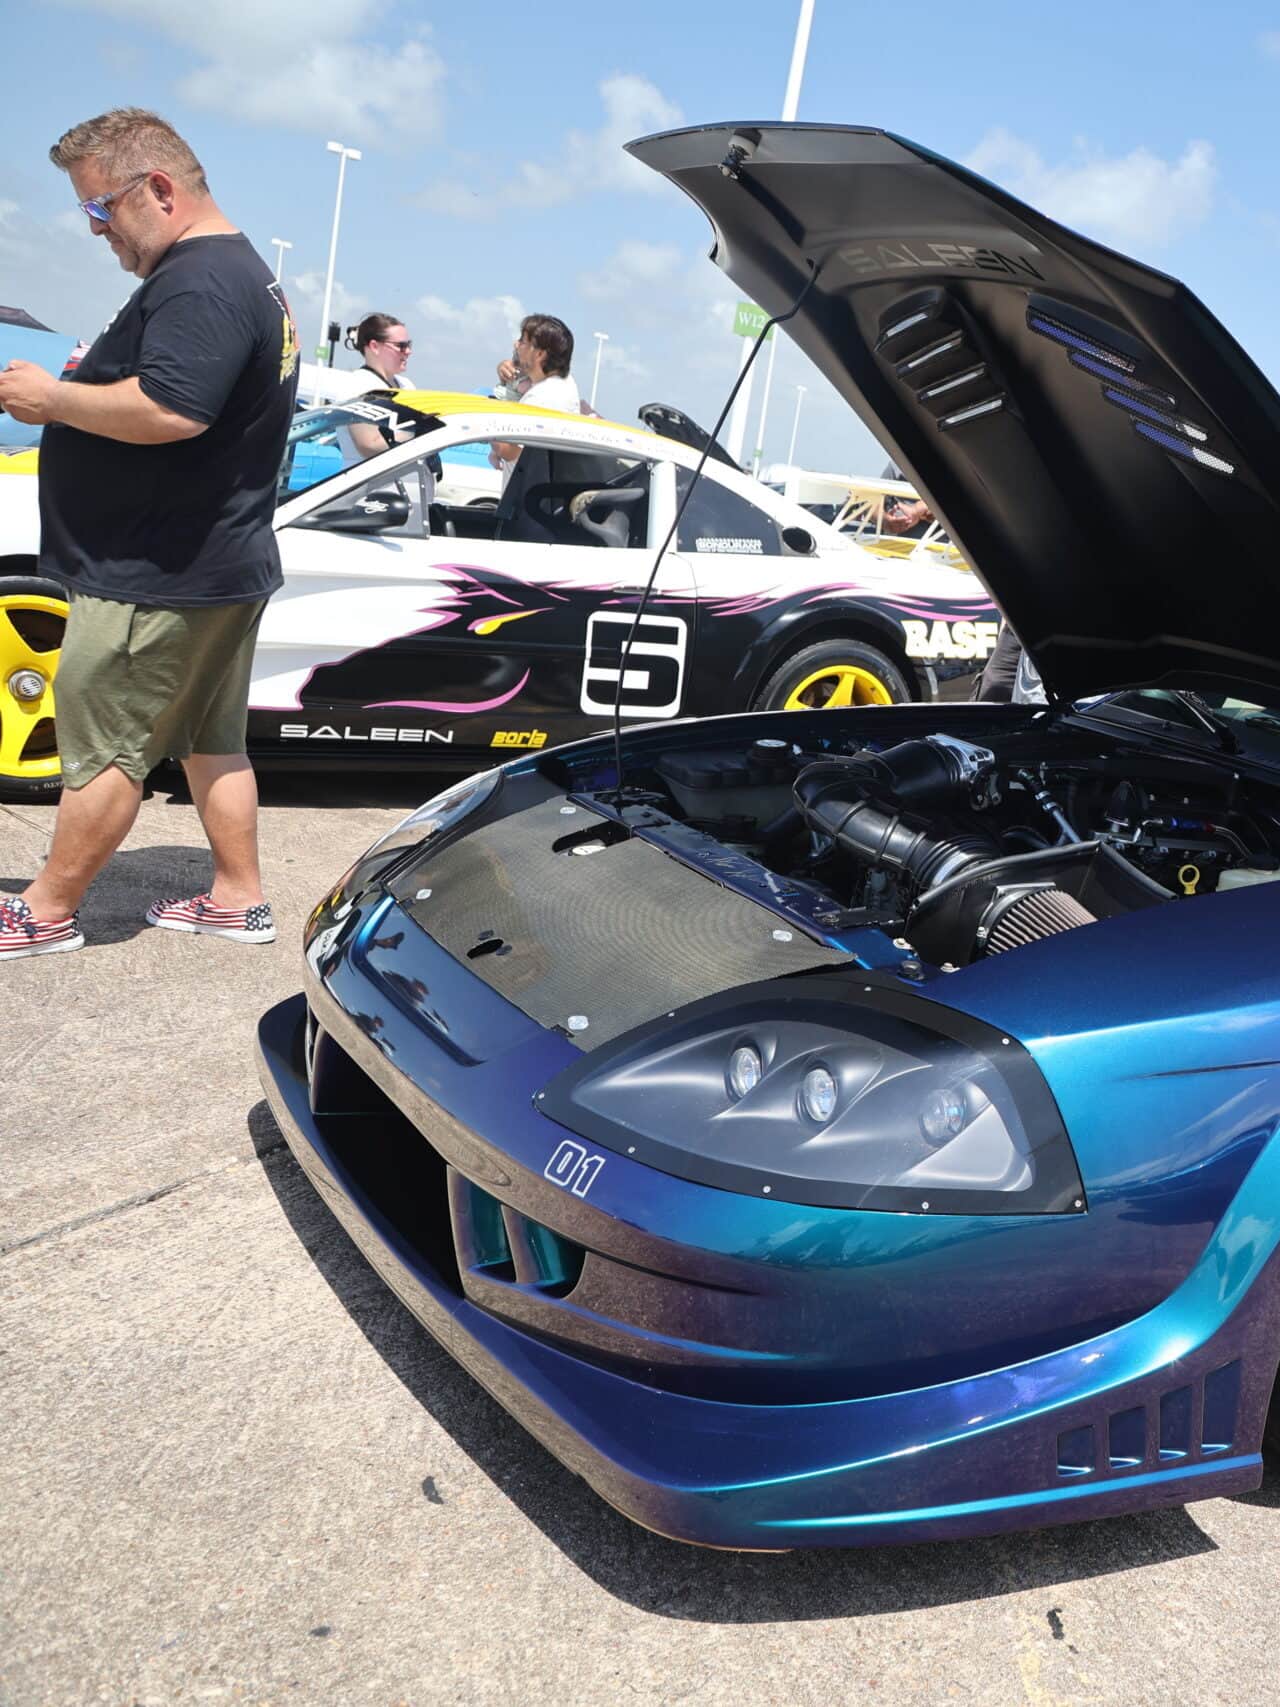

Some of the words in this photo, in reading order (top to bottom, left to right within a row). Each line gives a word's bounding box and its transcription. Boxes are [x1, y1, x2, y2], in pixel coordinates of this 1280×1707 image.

[840, 243, 1046, 282] SALEEN
[336, 401, 417, 430] EEN
[901, 620, 998, 659] BASF
[280, 724, 454, 744] SALEEN
[544, 1140, 606, 1198] 01
